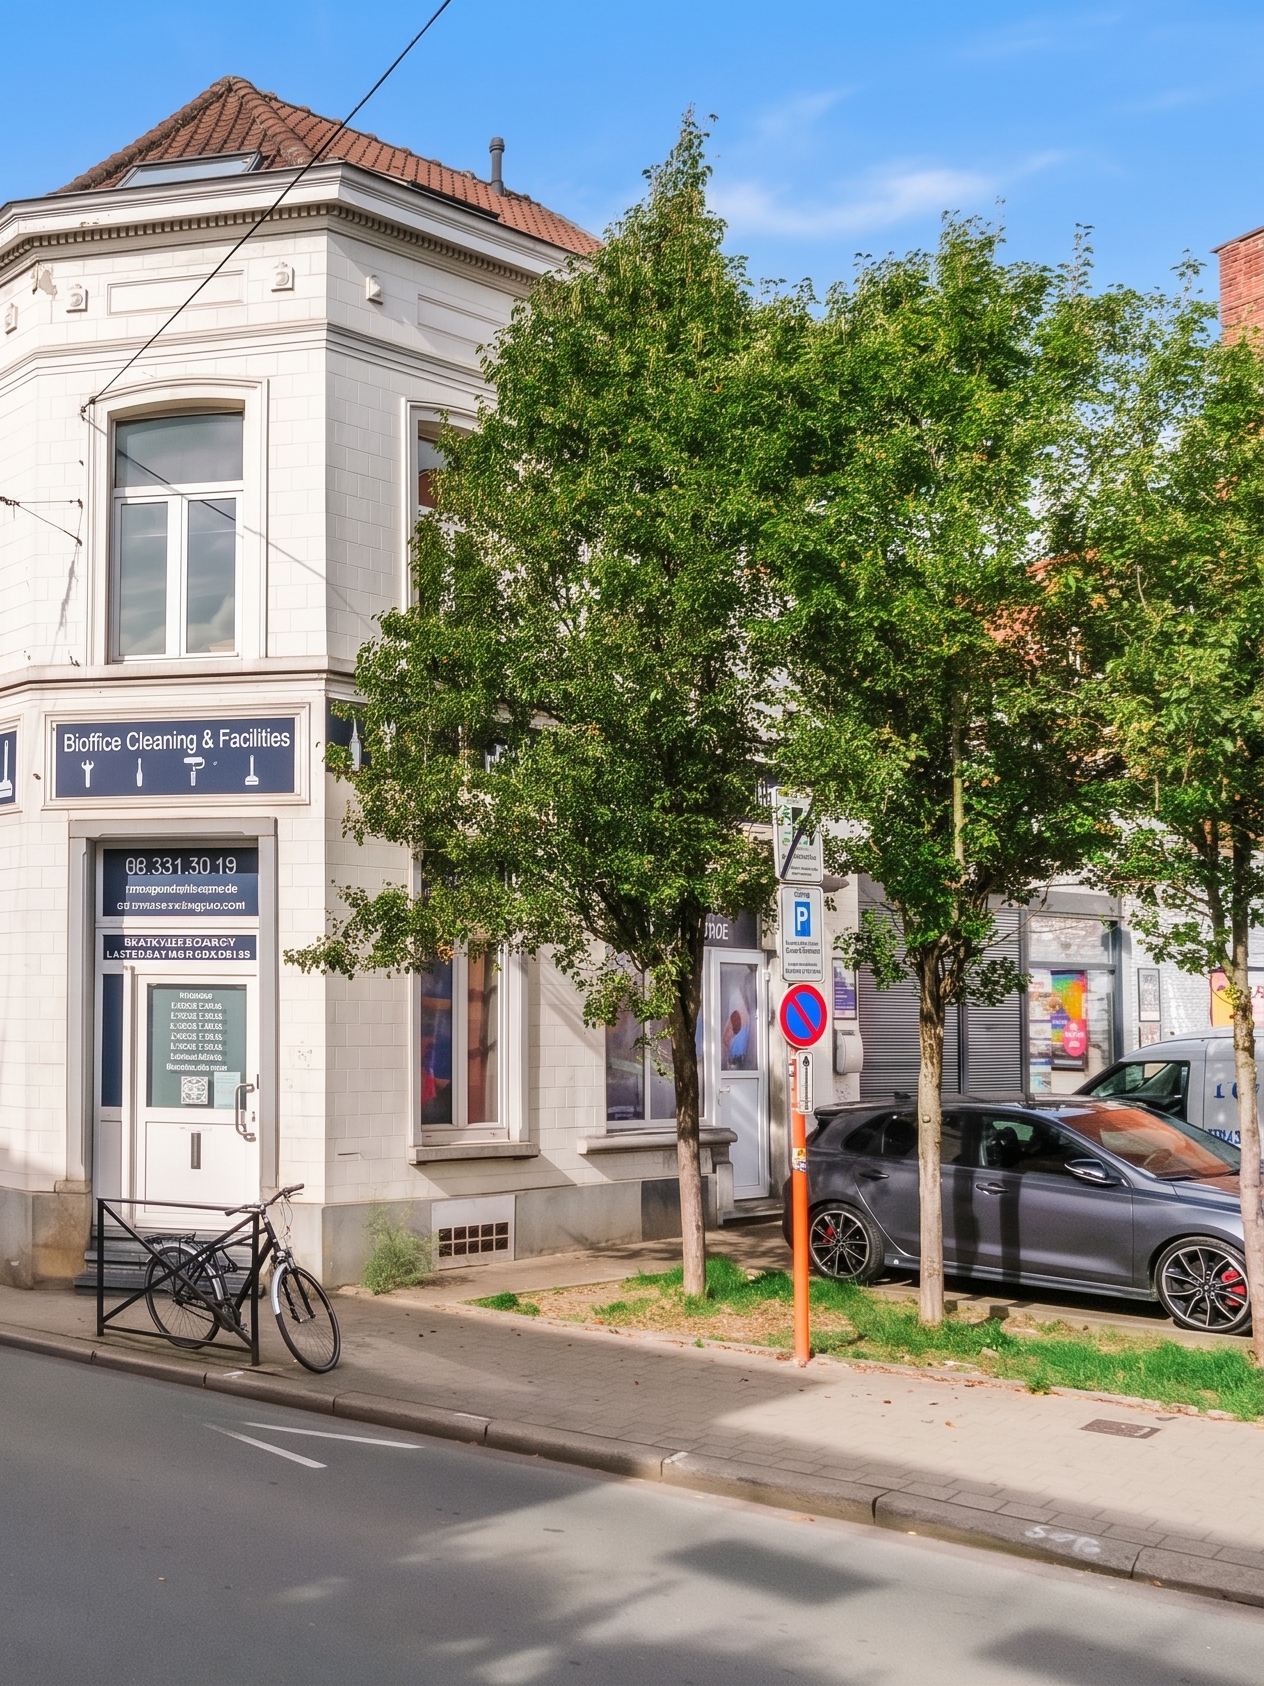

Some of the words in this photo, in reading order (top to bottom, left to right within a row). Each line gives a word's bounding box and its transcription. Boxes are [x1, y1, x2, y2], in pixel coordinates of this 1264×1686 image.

[63, 732, 122, 752] Bioffice
[126, 731, 198, 755] Cleaning
[202, 730, 215, 749] &
[219, 728, 291, 748] Facilities
